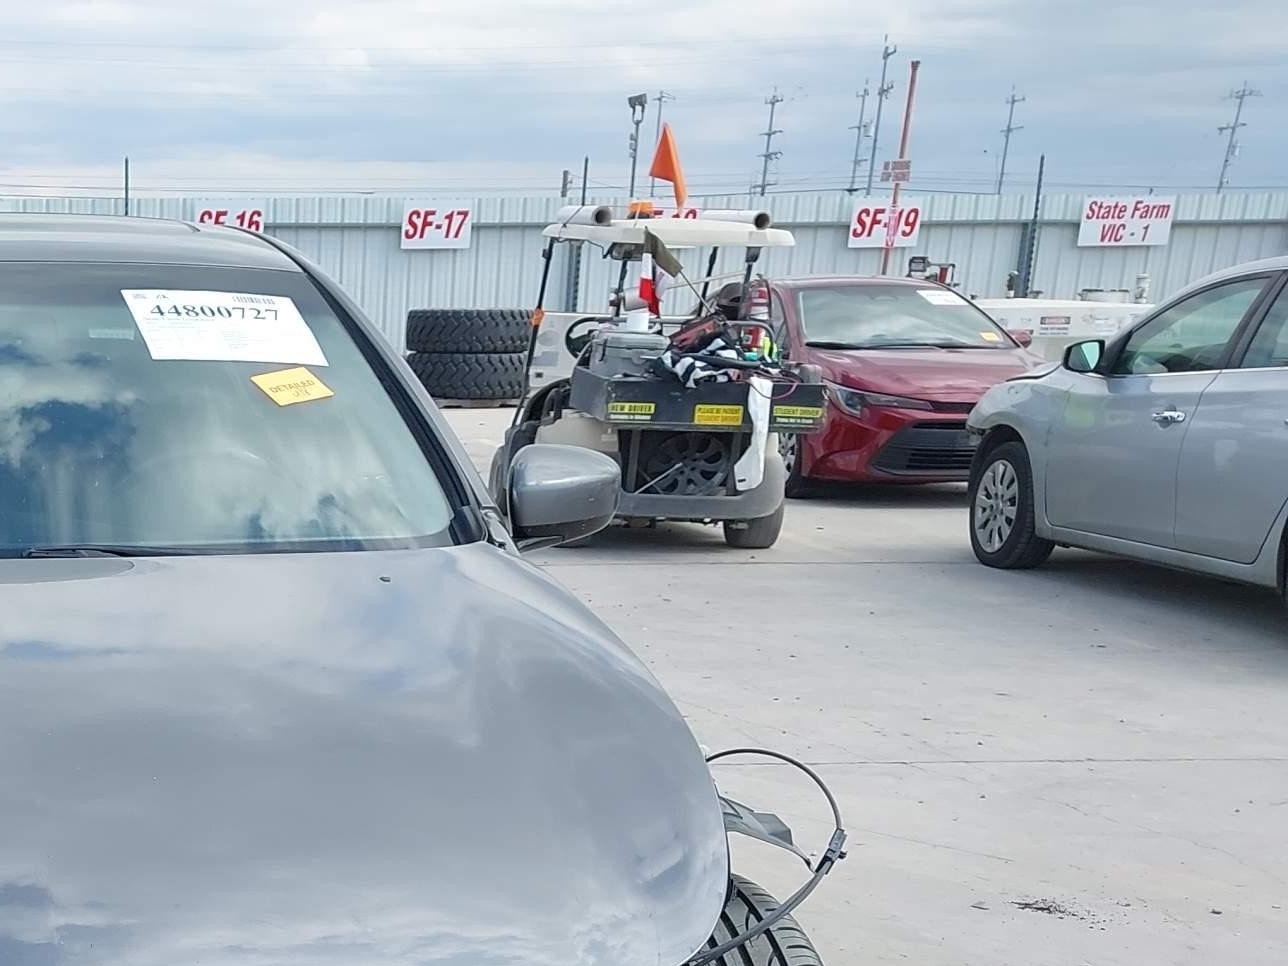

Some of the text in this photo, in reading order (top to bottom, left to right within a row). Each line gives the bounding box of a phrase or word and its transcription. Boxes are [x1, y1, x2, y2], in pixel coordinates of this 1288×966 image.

[1085, 200, 1171, 220] State Farm
[404, 209, 470, 240] SF-17
[1100, 223, 1126, 243] VIC
[1141, 223, 1150, 242] 1
[150, 304, 278, 321] 44800727
[269, 379, 315, 394] DETAILED
